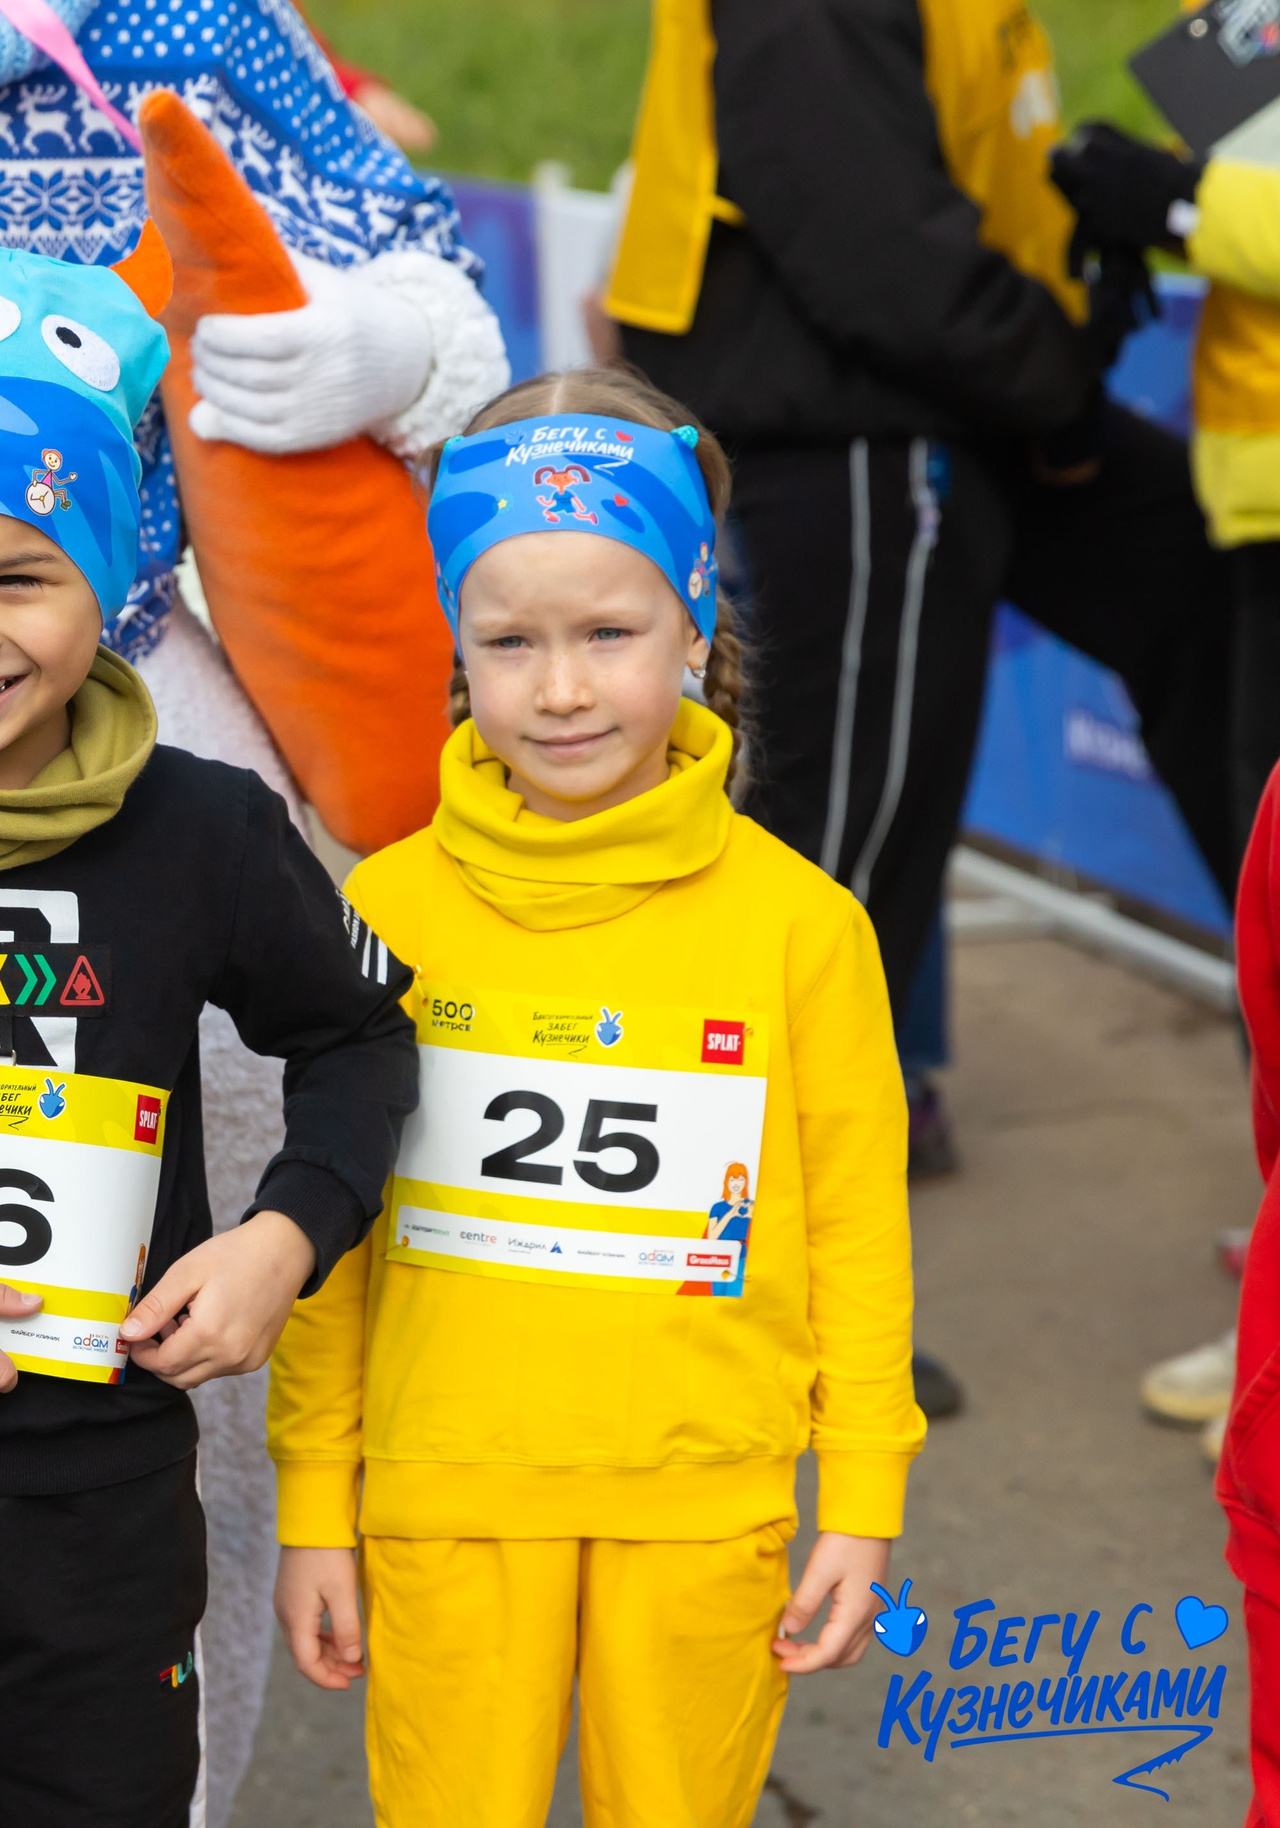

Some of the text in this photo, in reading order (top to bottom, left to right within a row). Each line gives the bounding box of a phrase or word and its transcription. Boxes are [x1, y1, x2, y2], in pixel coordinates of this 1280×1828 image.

[431, 999, 474, 1021] 500
[547, 1022, 578, 1031] ЗАБЕГ
[707, 1032, 740, 1052] SPLAT
[139, 1109, 158, 1130] SPLAT
[481, 1089, 661, 1194] 25
[459, 1230, 497, 1244] centre
